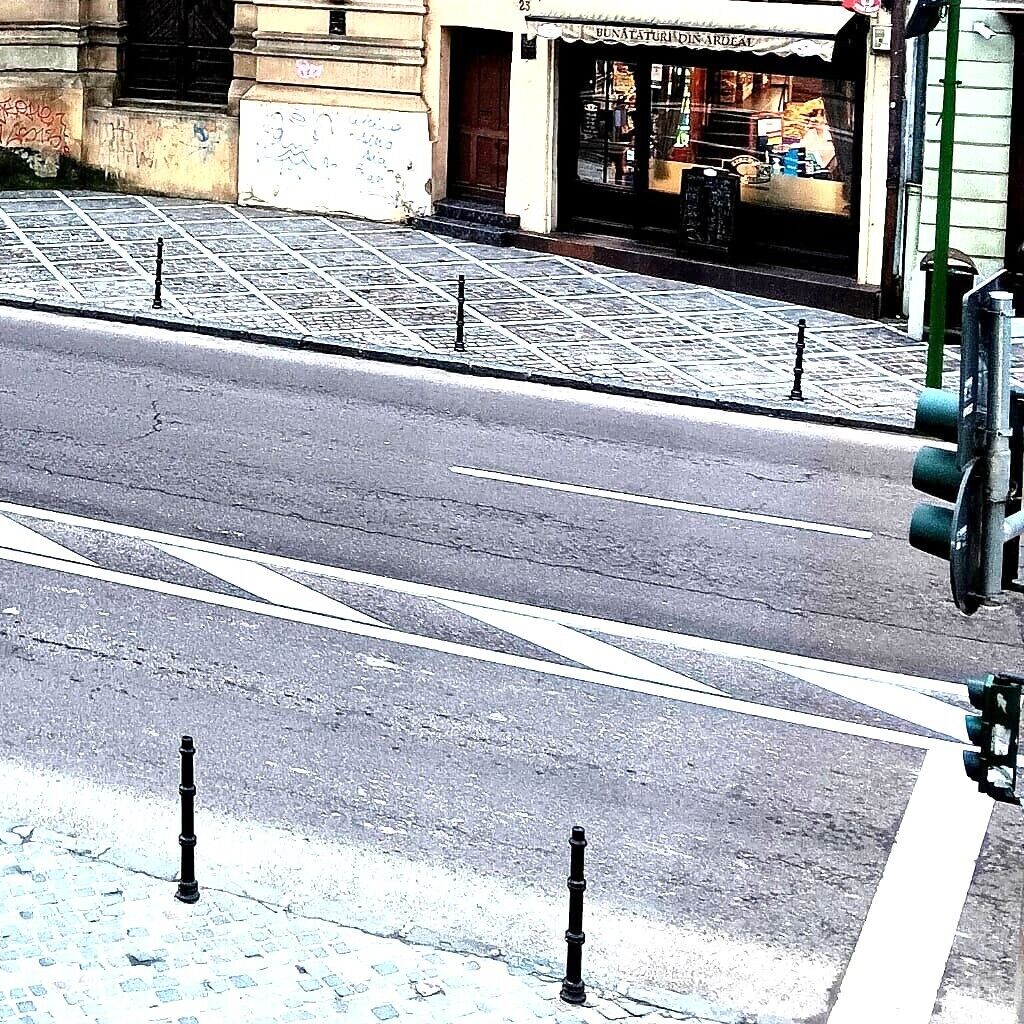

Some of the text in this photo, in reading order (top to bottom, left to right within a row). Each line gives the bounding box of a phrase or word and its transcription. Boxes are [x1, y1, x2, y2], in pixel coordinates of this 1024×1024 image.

[518, 0, 531, 12] 23
[678, 32, 701, 45] DIN
[704, 35, 754, 49] ARDEAL
